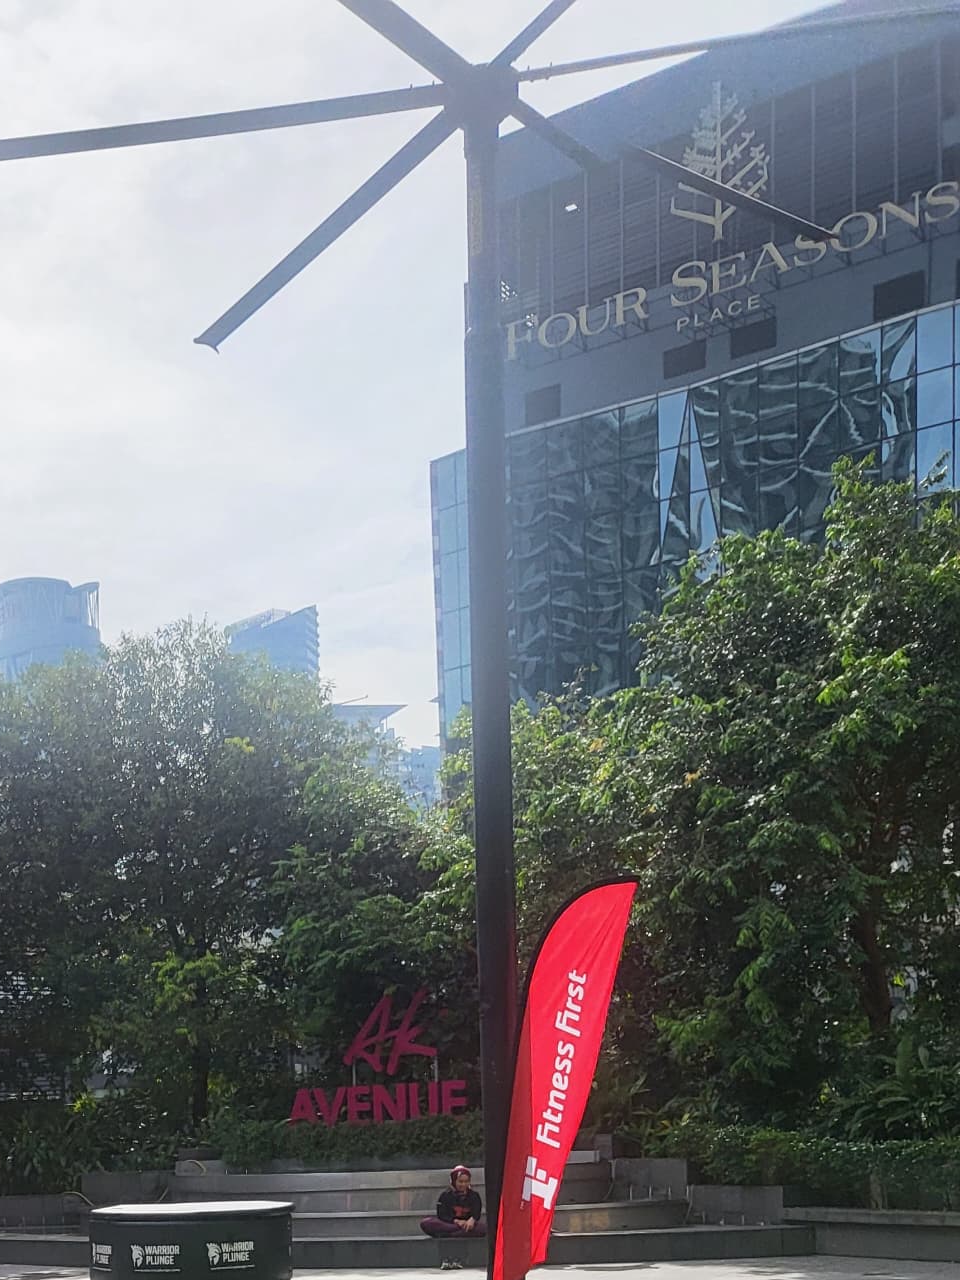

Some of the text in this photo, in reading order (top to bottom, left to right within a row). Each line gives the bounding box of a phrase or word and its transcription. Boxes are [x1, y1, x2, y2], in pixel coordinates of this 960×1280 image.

[504, 181, 960, 361] FOUR SEASONS
[676, 294, 761, 332] PLACE
[536, 969, 587, 1149] Fitness First
[290, 1079, 467, 1129] AVENUE
[144, 1245, 180, 1255] WARRIOR
[221, 1241, 254, 1252] WARRIOR
[223, 1251, 250, 1263] PLUNGE
[145, 1255, 175, 1265] PLUNGE
